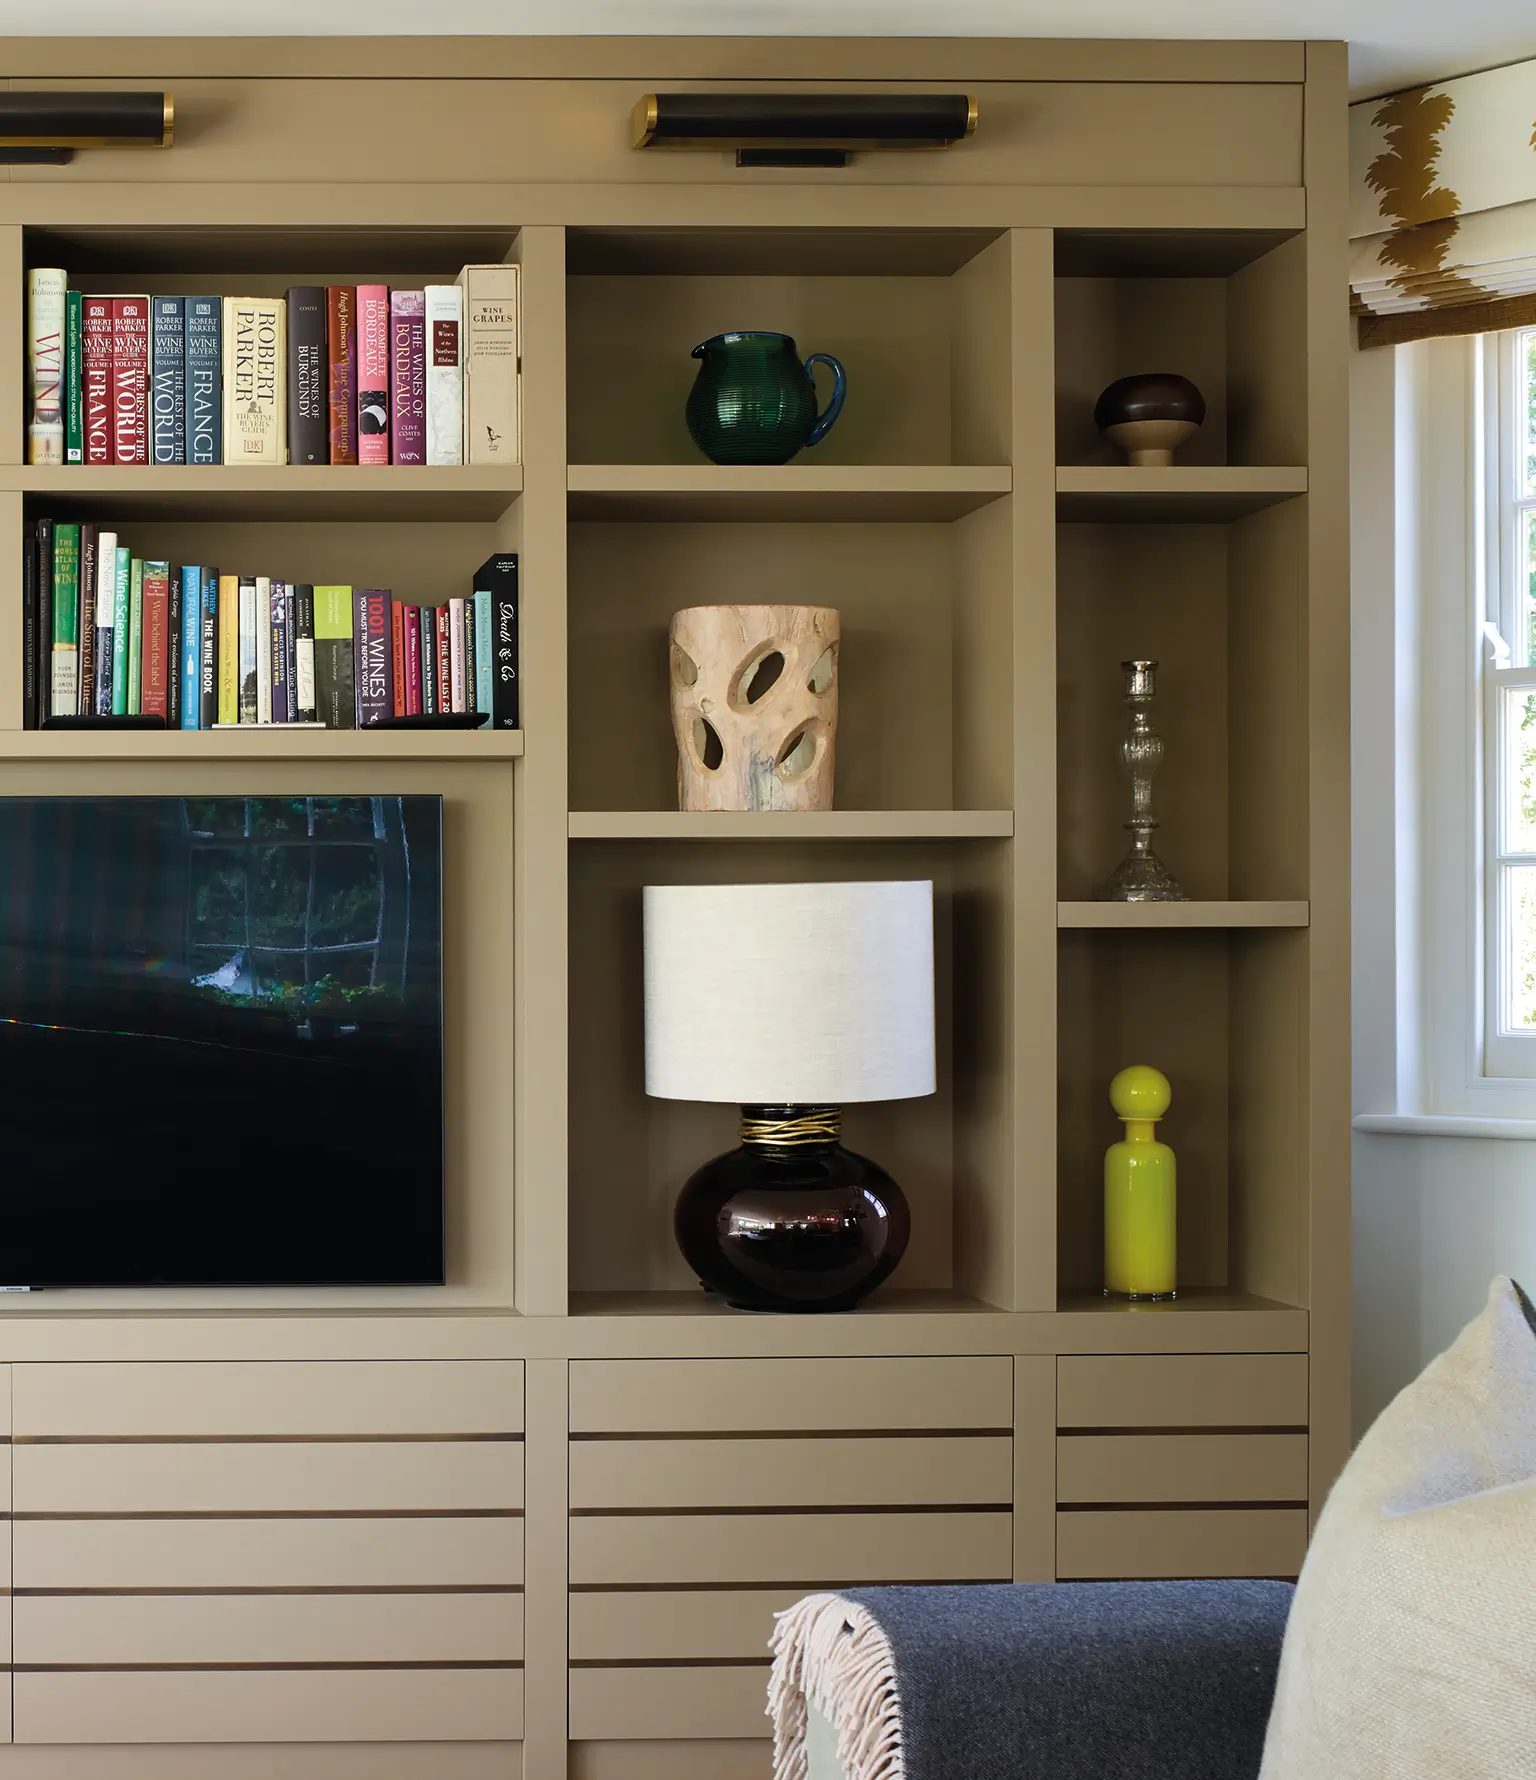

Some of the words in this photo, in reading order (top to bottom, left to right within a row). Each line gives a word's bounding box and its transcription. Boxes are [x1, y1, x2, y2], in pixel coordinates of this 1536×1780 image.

[32, 288, 65, 296] Robinson
[38, 278, 60, 287] Jancis
[338, 291, 348, 313] Hugh
[378, 299, 386, 321] THE
[473, 315, 513, 323] GRAPES
[83, 338, 112, 348] WINE
[114, 338, 146, 348] WINE
[156, 338, 184, 347] WINE
[190, 338, 218, 348] WINE
[338, 312, 349, 356] Johnson's
[366, 299, 378, 377] BORDEAUX
[412, 323, 422, 349] THE
[236, 311, 255, 402] PARKER
[257, 312, 276, 405] ROBERT
[310, 344, 319, 366] THE
[378, 322, 386, 376] COMPLETE
[35, 332, 60, 424] WINE
[136, 368, 145, 391] THE
[175, 369, 184, 391] THE
[298, 345, 310, 418] BURGUNDY
[396, 324, 411, 418] BORDEAUX
[412, 354, 423, 396] WINES
[310, 367, 320, 401] WINES
[89, 370, 107, 461] FRANCE
[116, 368, 136, 462] WORLD
[136, 393, 145, 420] REST
[155, 369, 175, 462] WORLD
[175, 394, 184, 420] REST
[193, 370, 213, 463] FRANCE
[311, 404, 320, 419] OF
[412, 399, 423, 418] OF
[136, 421, 145, 436] OF
[175, 422, 184, 437] OF
[338, 389, 351, 452] Companion
[136, 437, 145, 461] THE
[175, 441, 184, 462] THE
[246, 440, 260, 450] DK
[85, 543, 94, 562] Hugh
[104, 547, 113, 562] The
[54, 573, 77, 584] WINE
[85, 561, 94, 591] Johnson
[104, 564, 112, 587] New
[117, 569, 129, 602] Wine
[103, 589, 112, 618] France
[186, 572, 196, 617] NATURAL
[209, 579, 217, 615] MATTHEW
[85, 599, 95, 620] The
[152, 601, 161, 622] Wine
[368, 596, 384, 634] 1001
[115, 605, 127, 653] Science
[186, 618, 196, 647] WINE
[204, 619, 213, 638] THE
[498, 601, 515, 643] Death
[84, 623, 95, 654] Story
[151, 624, 160, 651] behind
[441, 640, 449, 657] THE
[84, 656, 93, 667] of
[151, 653, 160, 666] the
[204, 639, 213, 665] WINE
[498, 647, 512, 662] &
[151, 667, 160, 686] label
[361, 671, 369, 685] YOU
[369, 638, 386, 698] WINES
[441, 659, 449, 681] WINE
[500, 665, 516, 683] Co
[83, 674, 94, 704] Wine
[203, 667, 213, 694] BOOK
